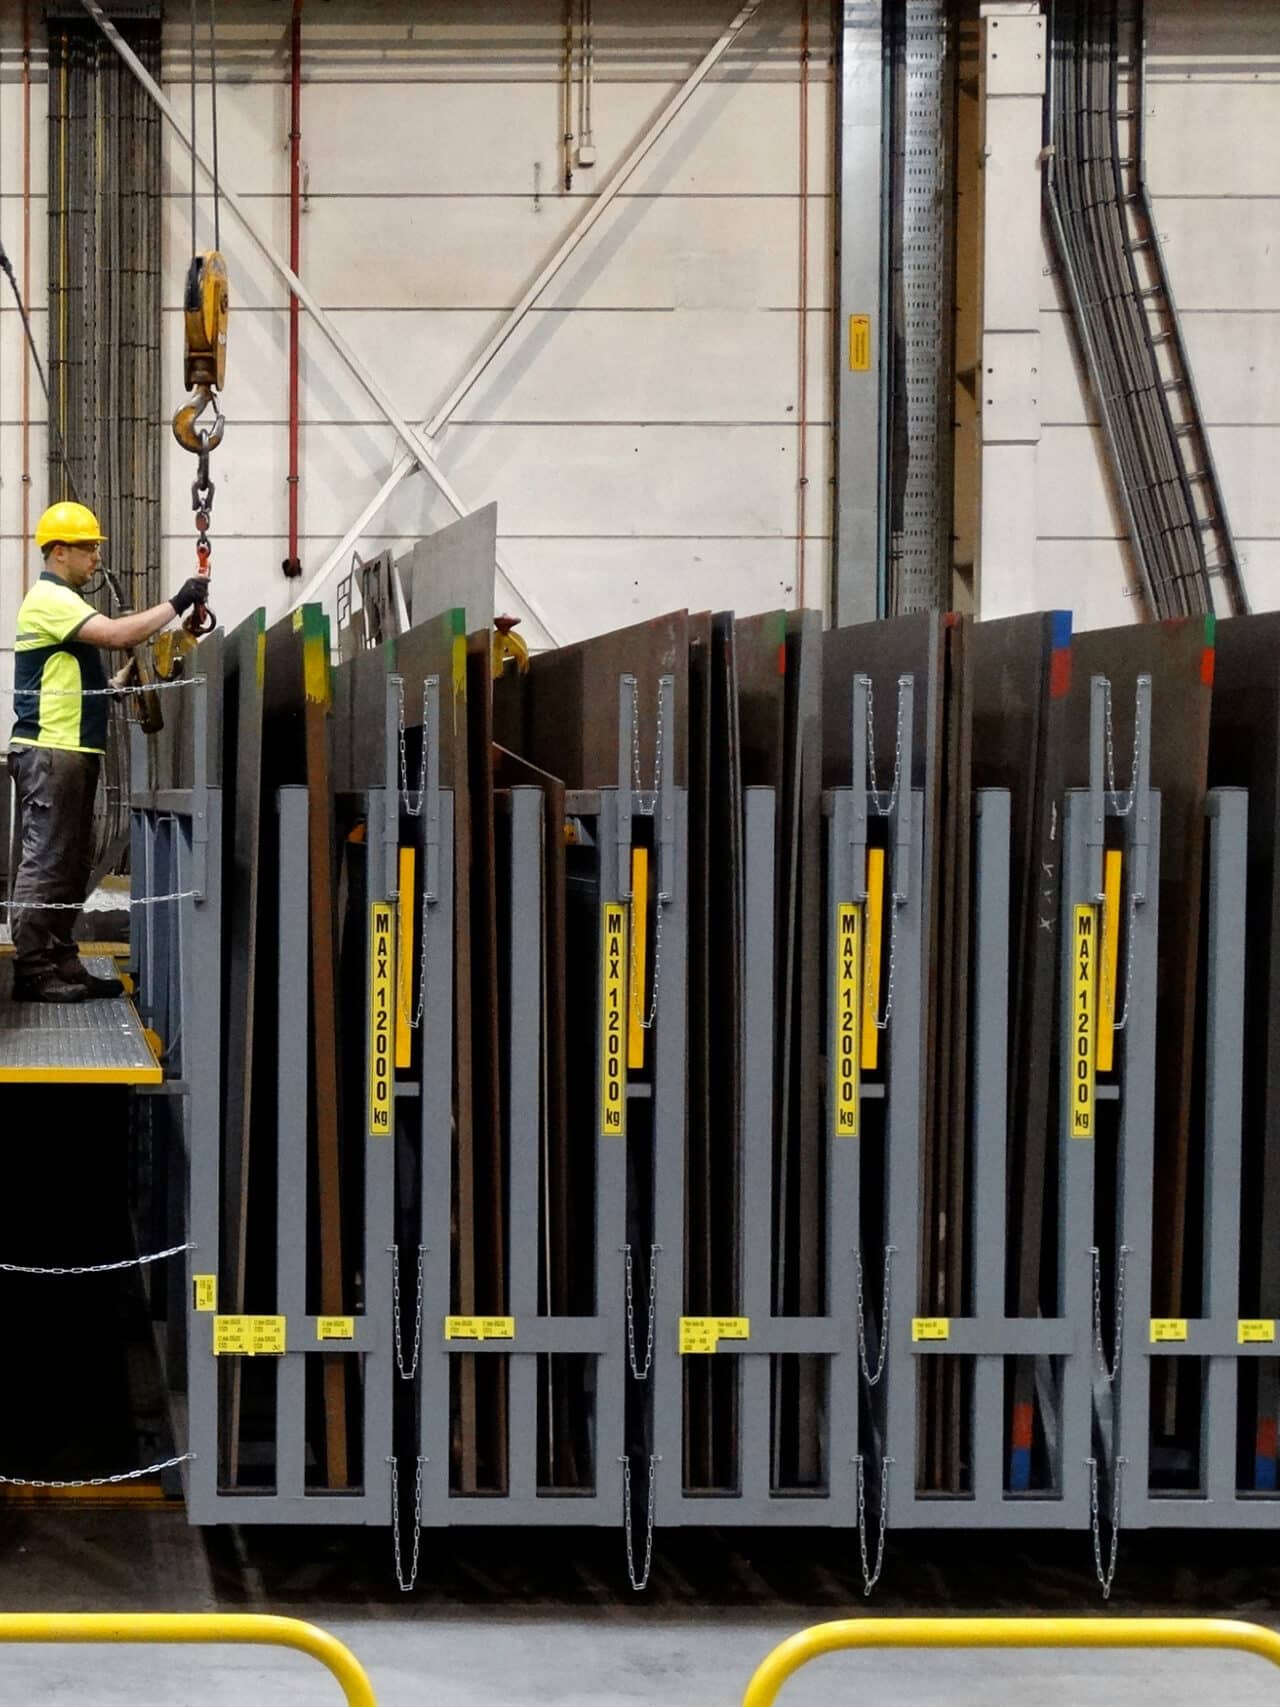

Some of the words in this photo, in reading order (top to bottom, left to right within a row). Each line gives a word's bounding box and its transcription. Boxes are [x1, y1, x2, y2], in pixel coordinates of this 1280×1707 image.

[376, 913, 389, 979] MAX
[608, 913, 622, 979] MAX
[842, 914, 855, 979] MAX
[1078, 916, 1092, 981] MAX
[376, 987, 387, 1101] 12000
[608, 987, 619, 1102] 12000
[842, 988, 853, 1102] 12000
[1077, 990, 1089, 1103] 12000
[373, 1107, 388, 1127] kg
[606, 1108, 620, 1128] kg
[839, 1108, 854, 1128] kg
[1075, 1110, 1089, 1130] kg
